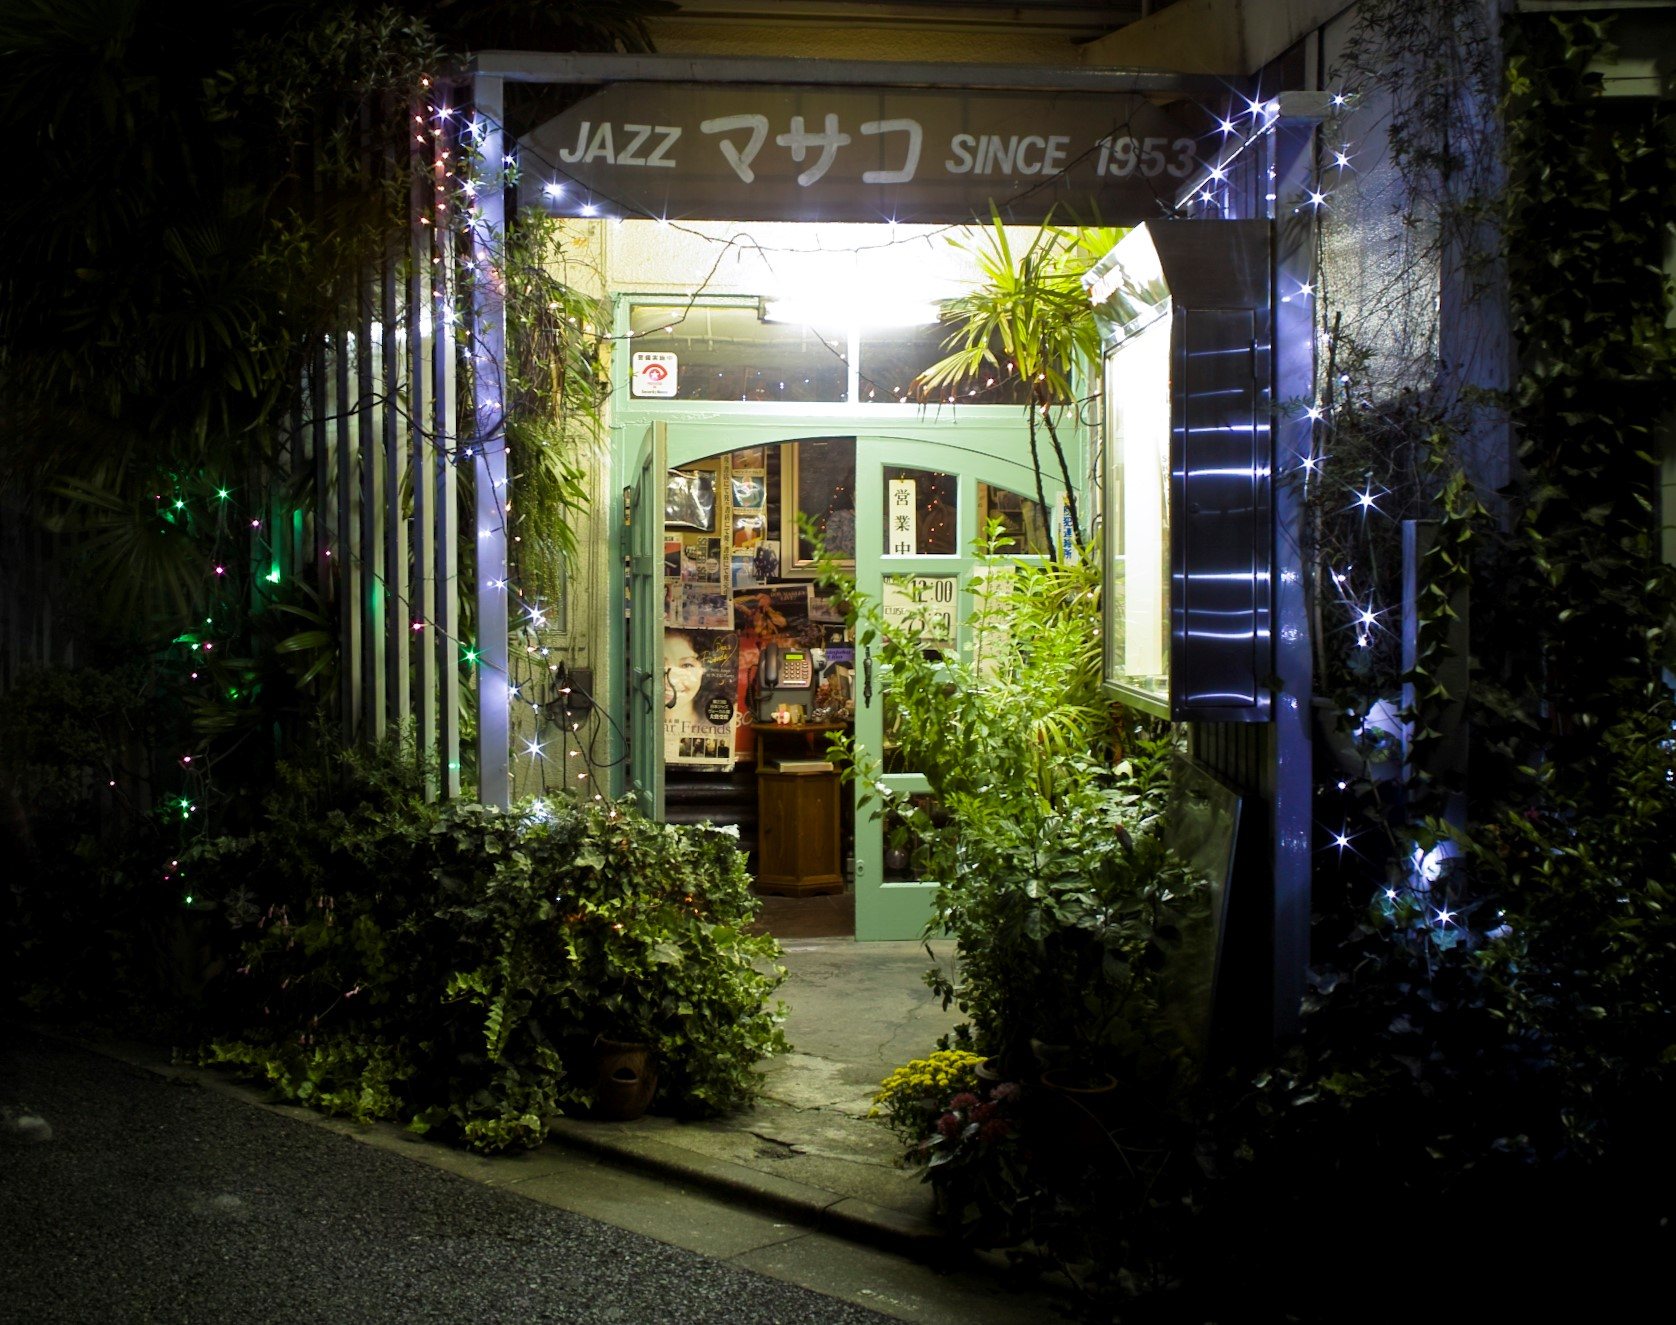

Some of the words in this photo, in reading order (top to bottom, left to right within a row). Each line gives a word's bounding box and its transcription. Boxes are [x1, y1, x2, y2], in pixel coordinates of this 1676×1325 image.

[559, 121, 683, 168] JAZZ
[699, 112, 923, 187] マサコ
[945, 133, 1071, 176] SINCE
[1096, 135, 1197, 178] 1953
[893, 488, 911, 555] 営業中
[911, 580, 953, 603] 12:00
[682, 721, 731, 735] Friends
